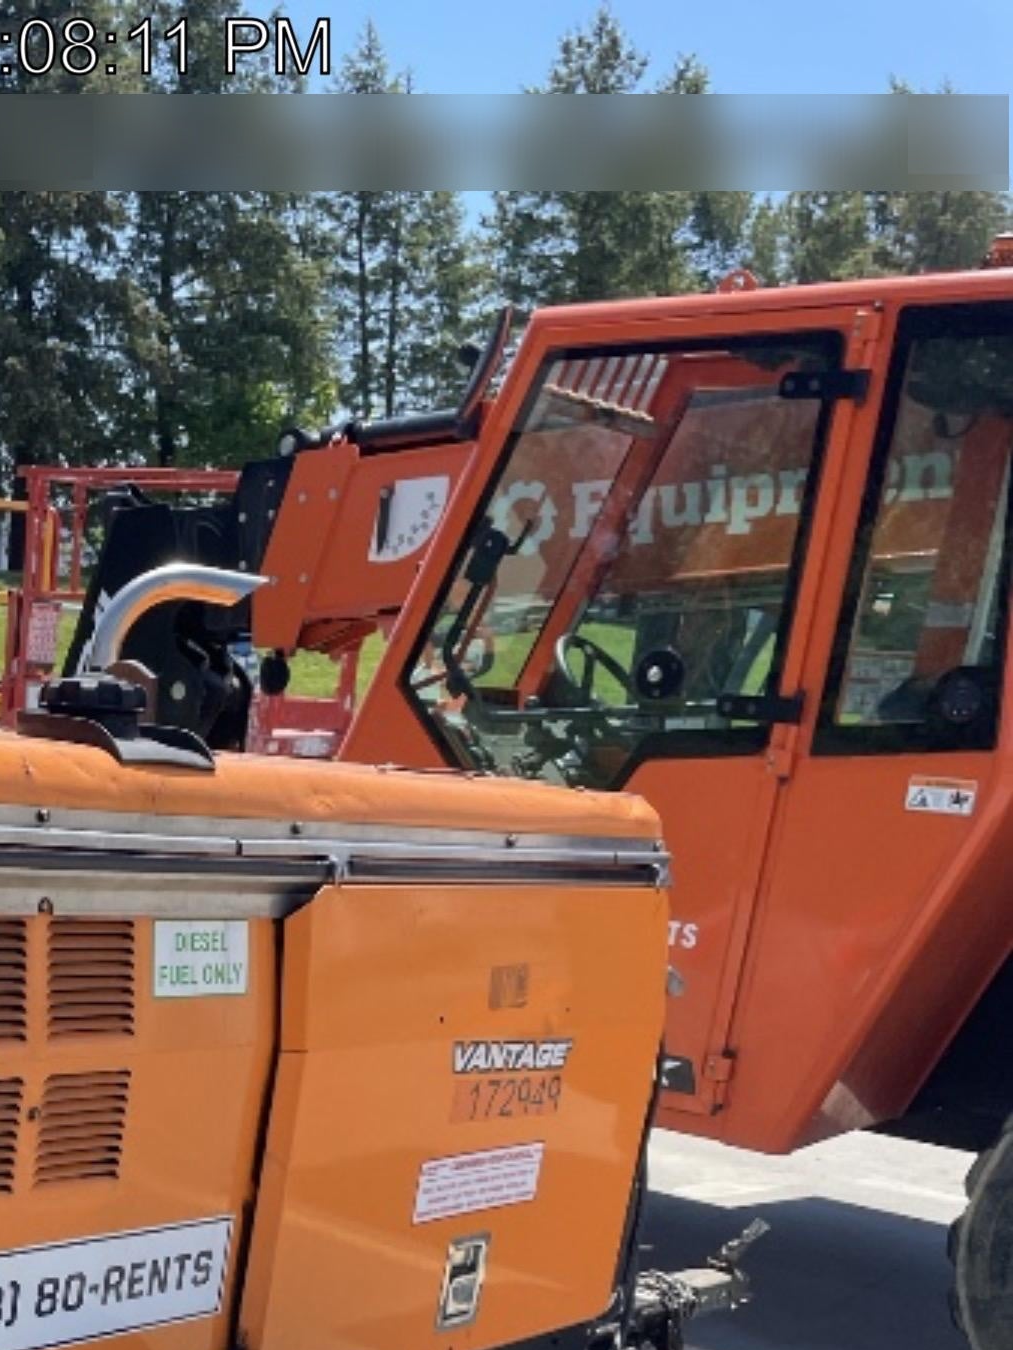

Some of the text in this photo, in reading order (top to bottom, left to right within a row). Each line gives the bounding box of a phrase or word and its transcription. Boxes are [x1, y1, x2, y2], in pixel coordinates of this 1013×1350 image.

[175, 931, 228, 952] DIESEL
[158, 962, 243, 986] FUEL ONLY
[453, 1041, 572, 1073] VANTAGE
[469, 1075, 561, 1120] 172949
[35, 1250, 213, 1317] 80-RENTS
